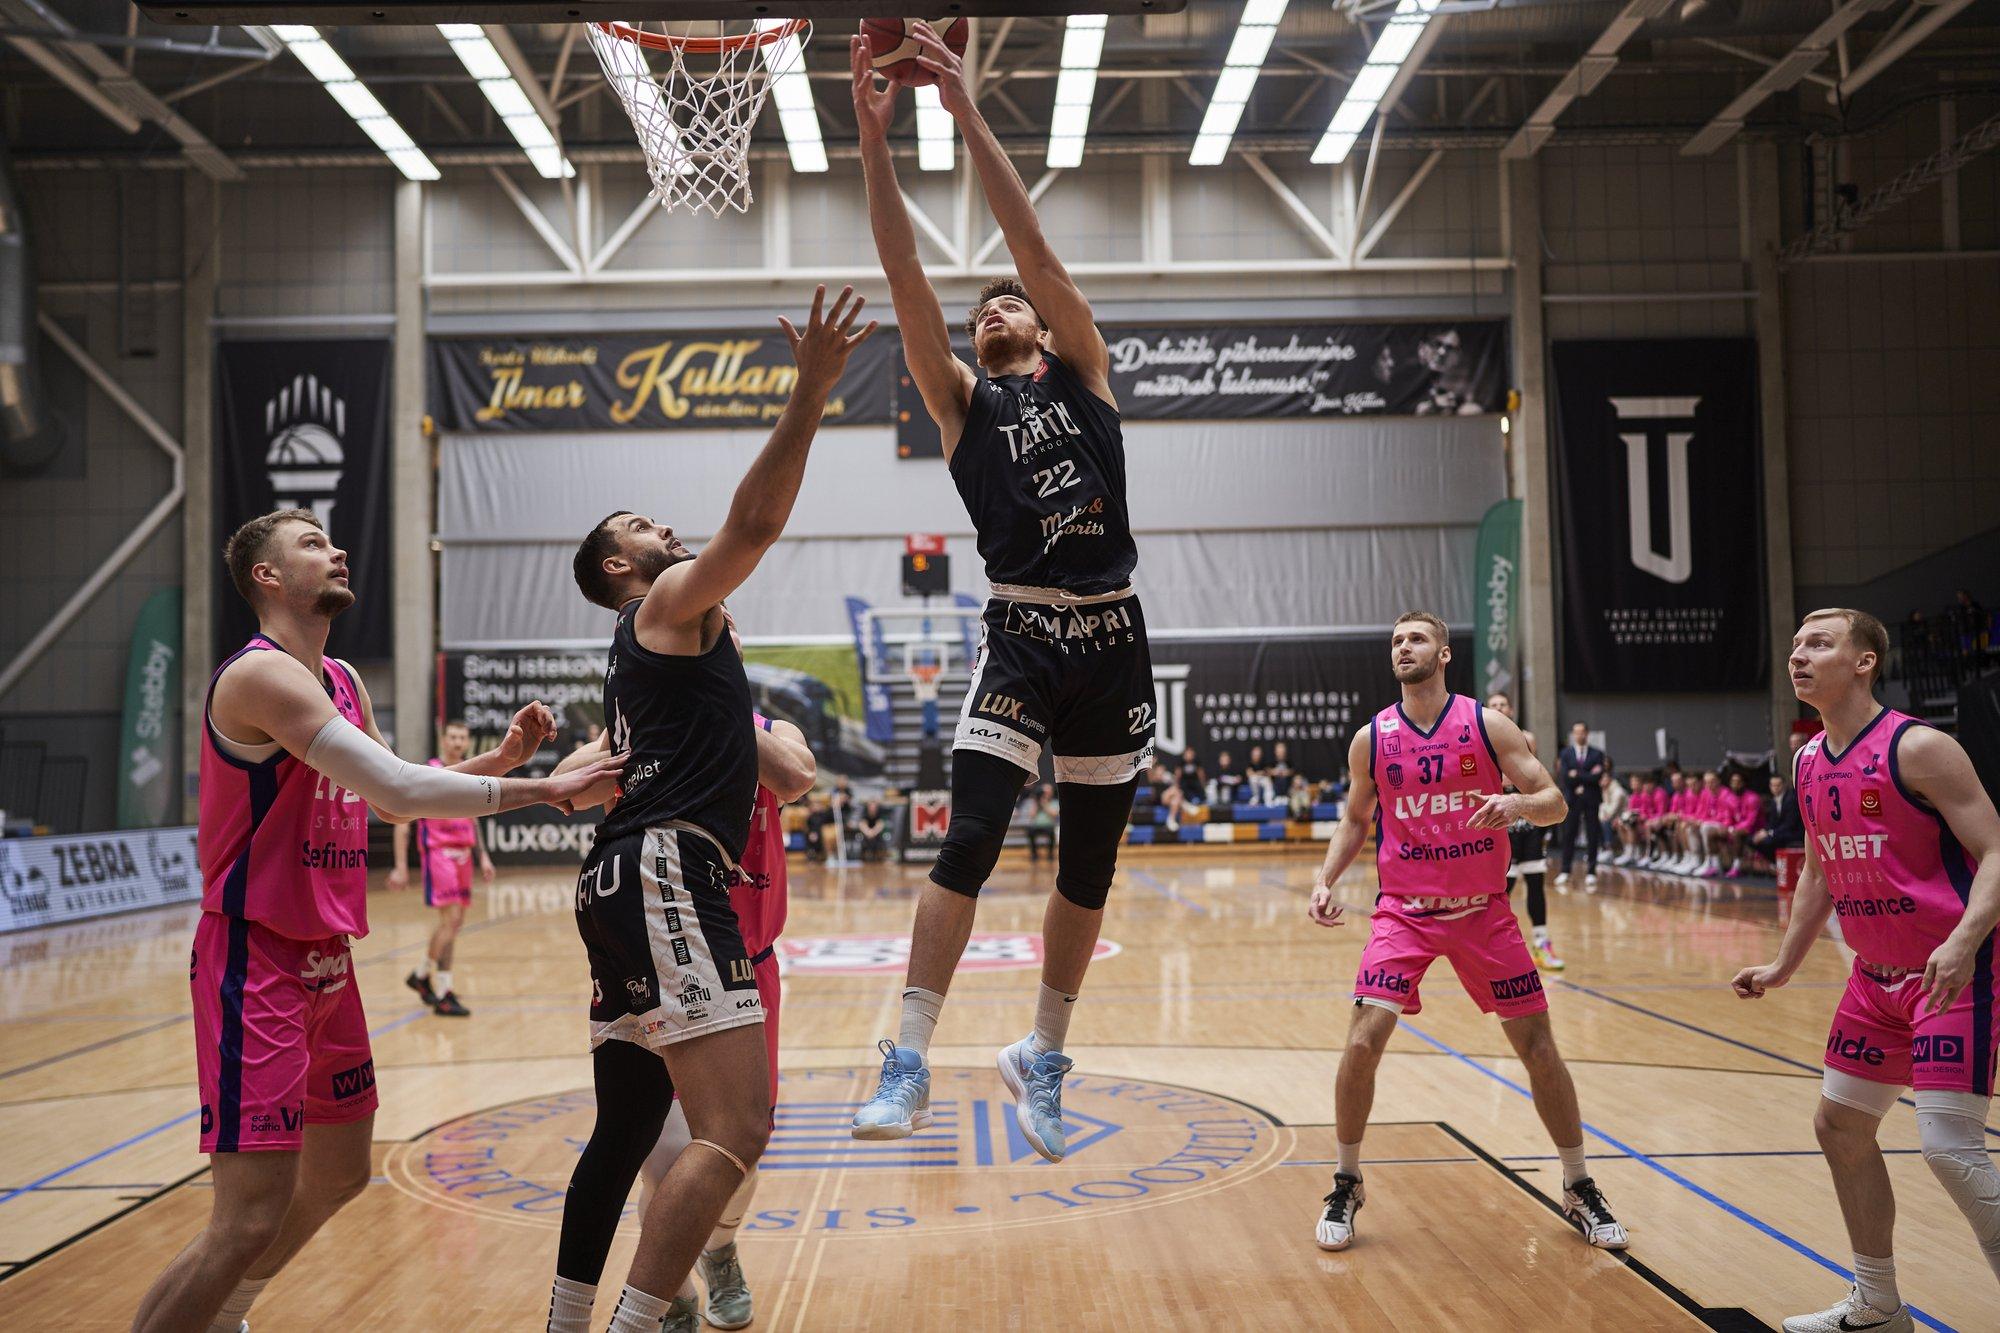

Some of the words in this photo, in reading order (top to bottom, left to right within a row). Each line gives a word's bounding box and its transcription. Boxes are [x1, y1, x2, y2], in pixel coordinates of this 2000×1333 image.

[997, 401, 1082, 463] TARTU
[1032, 459, 1082, 499] 22
[1486, 554, 1514, 651] Stebby
[464, 655, 516, 678] Sinu
[464, 680, 516, 703] Sinu
[1195, 694, 1257, 708] TARTU
[978, 692, 1025, 721] LUX
[1128, 702, 1157, 736] 22
[1020, 714, 1046, 735] Express
[1417, 755, 1444, 785] 37
[1828, 786, 1842, 822] 3
[486, 818, 598, 860] luxexp
[1409, 820, 1464, 837] CORE
[53, 840, 140, 887] ZEBRA
[303, 841, 368, 869] Sefinan
[1399, 837, 1495, 861] Sefinance
[676, 987, 712, 1008] TARTU
